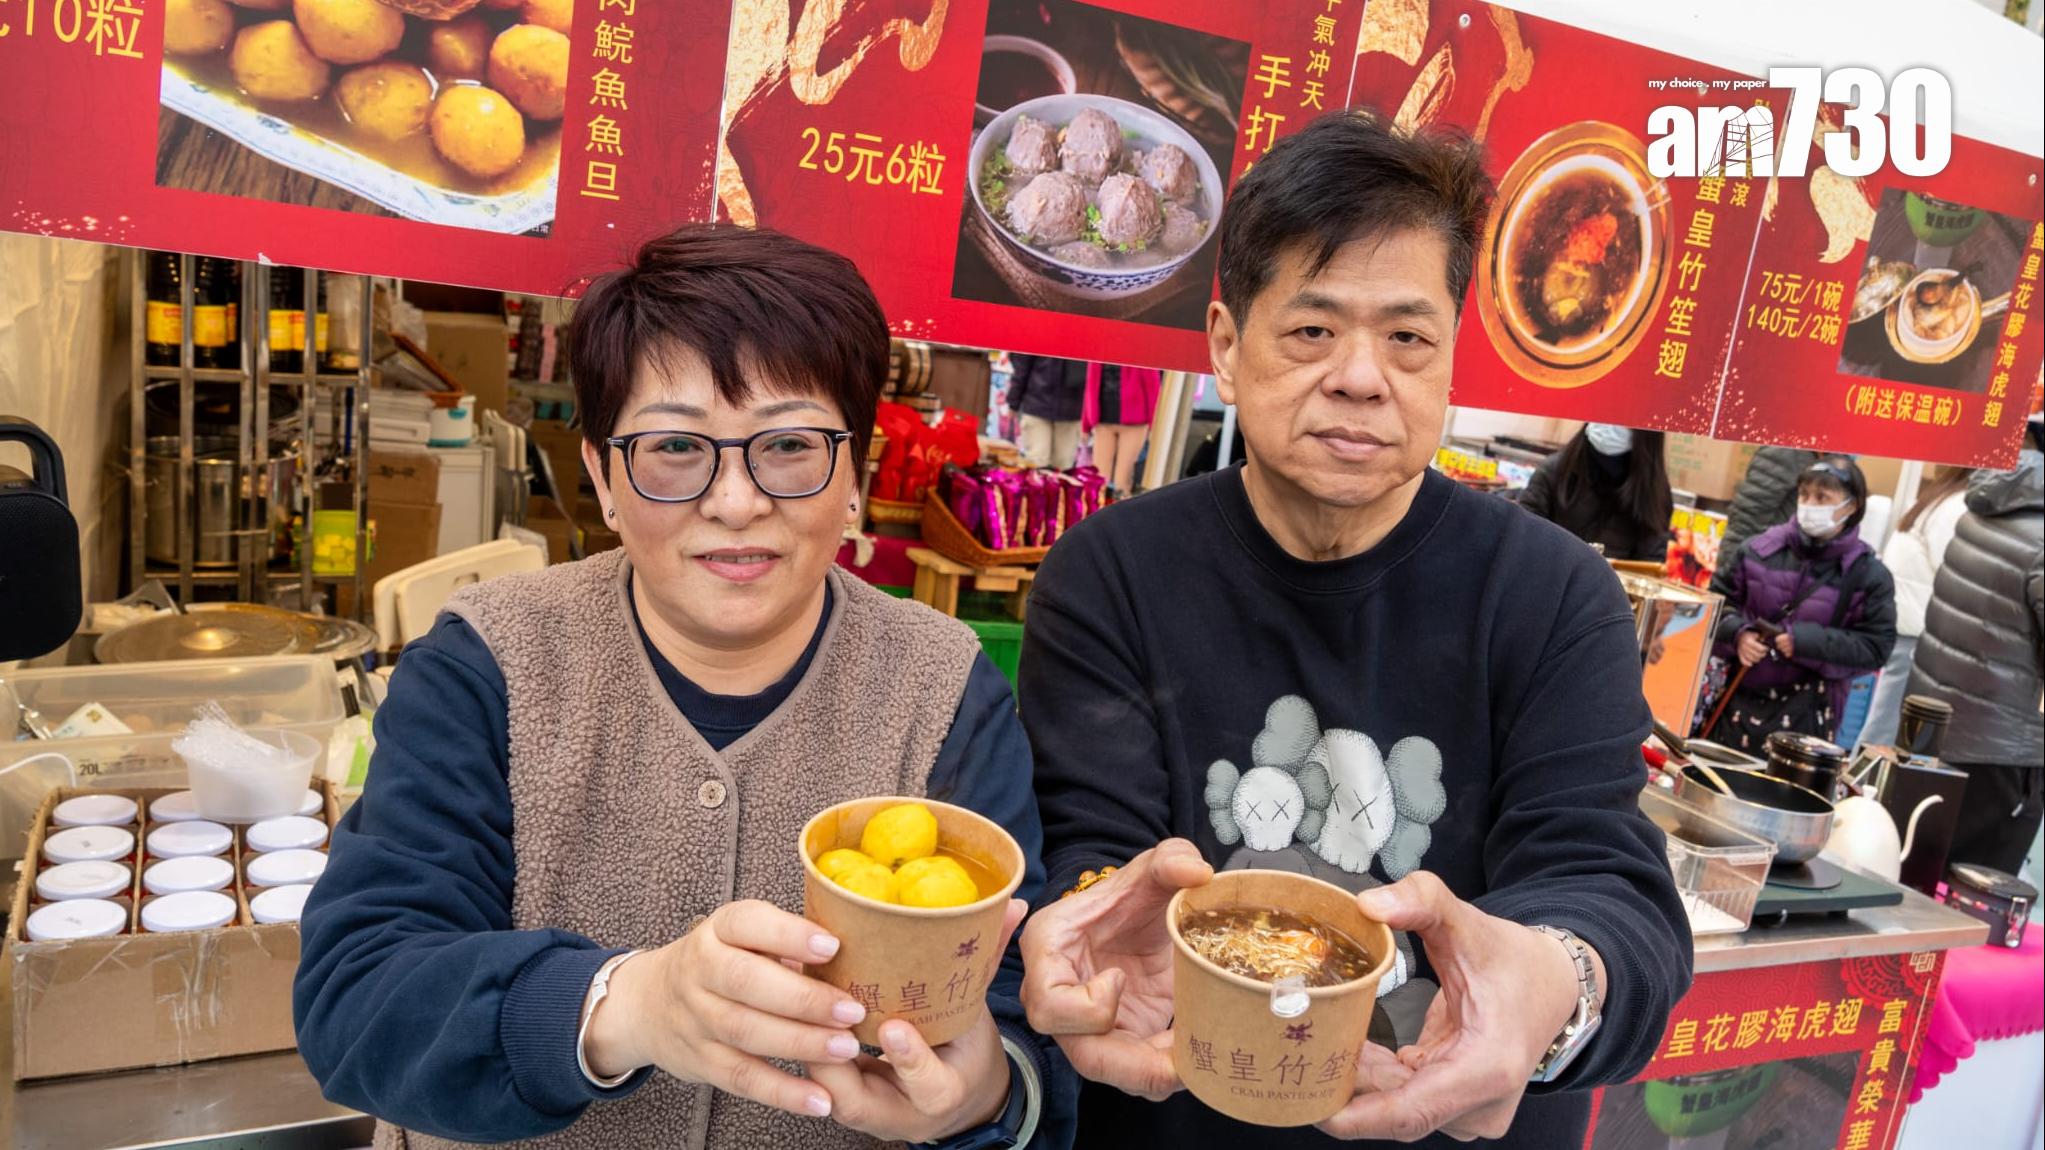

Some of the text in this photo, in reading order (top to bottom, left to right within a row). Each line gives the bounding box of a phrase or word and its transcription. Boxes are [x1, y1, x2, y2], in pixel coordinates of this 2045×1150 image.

[0, 0, 144, 59] 10粒
[1240, 54, 1292, 180] 手打
[799, 127, 946, 195] 25元6粒
[1760, 271, 1844, 312] 75元/1碗
[1747, 304, 1842, 346] 140元/2碗
[1651, 998, 1863, 1061] 皇花膠海虎翅
